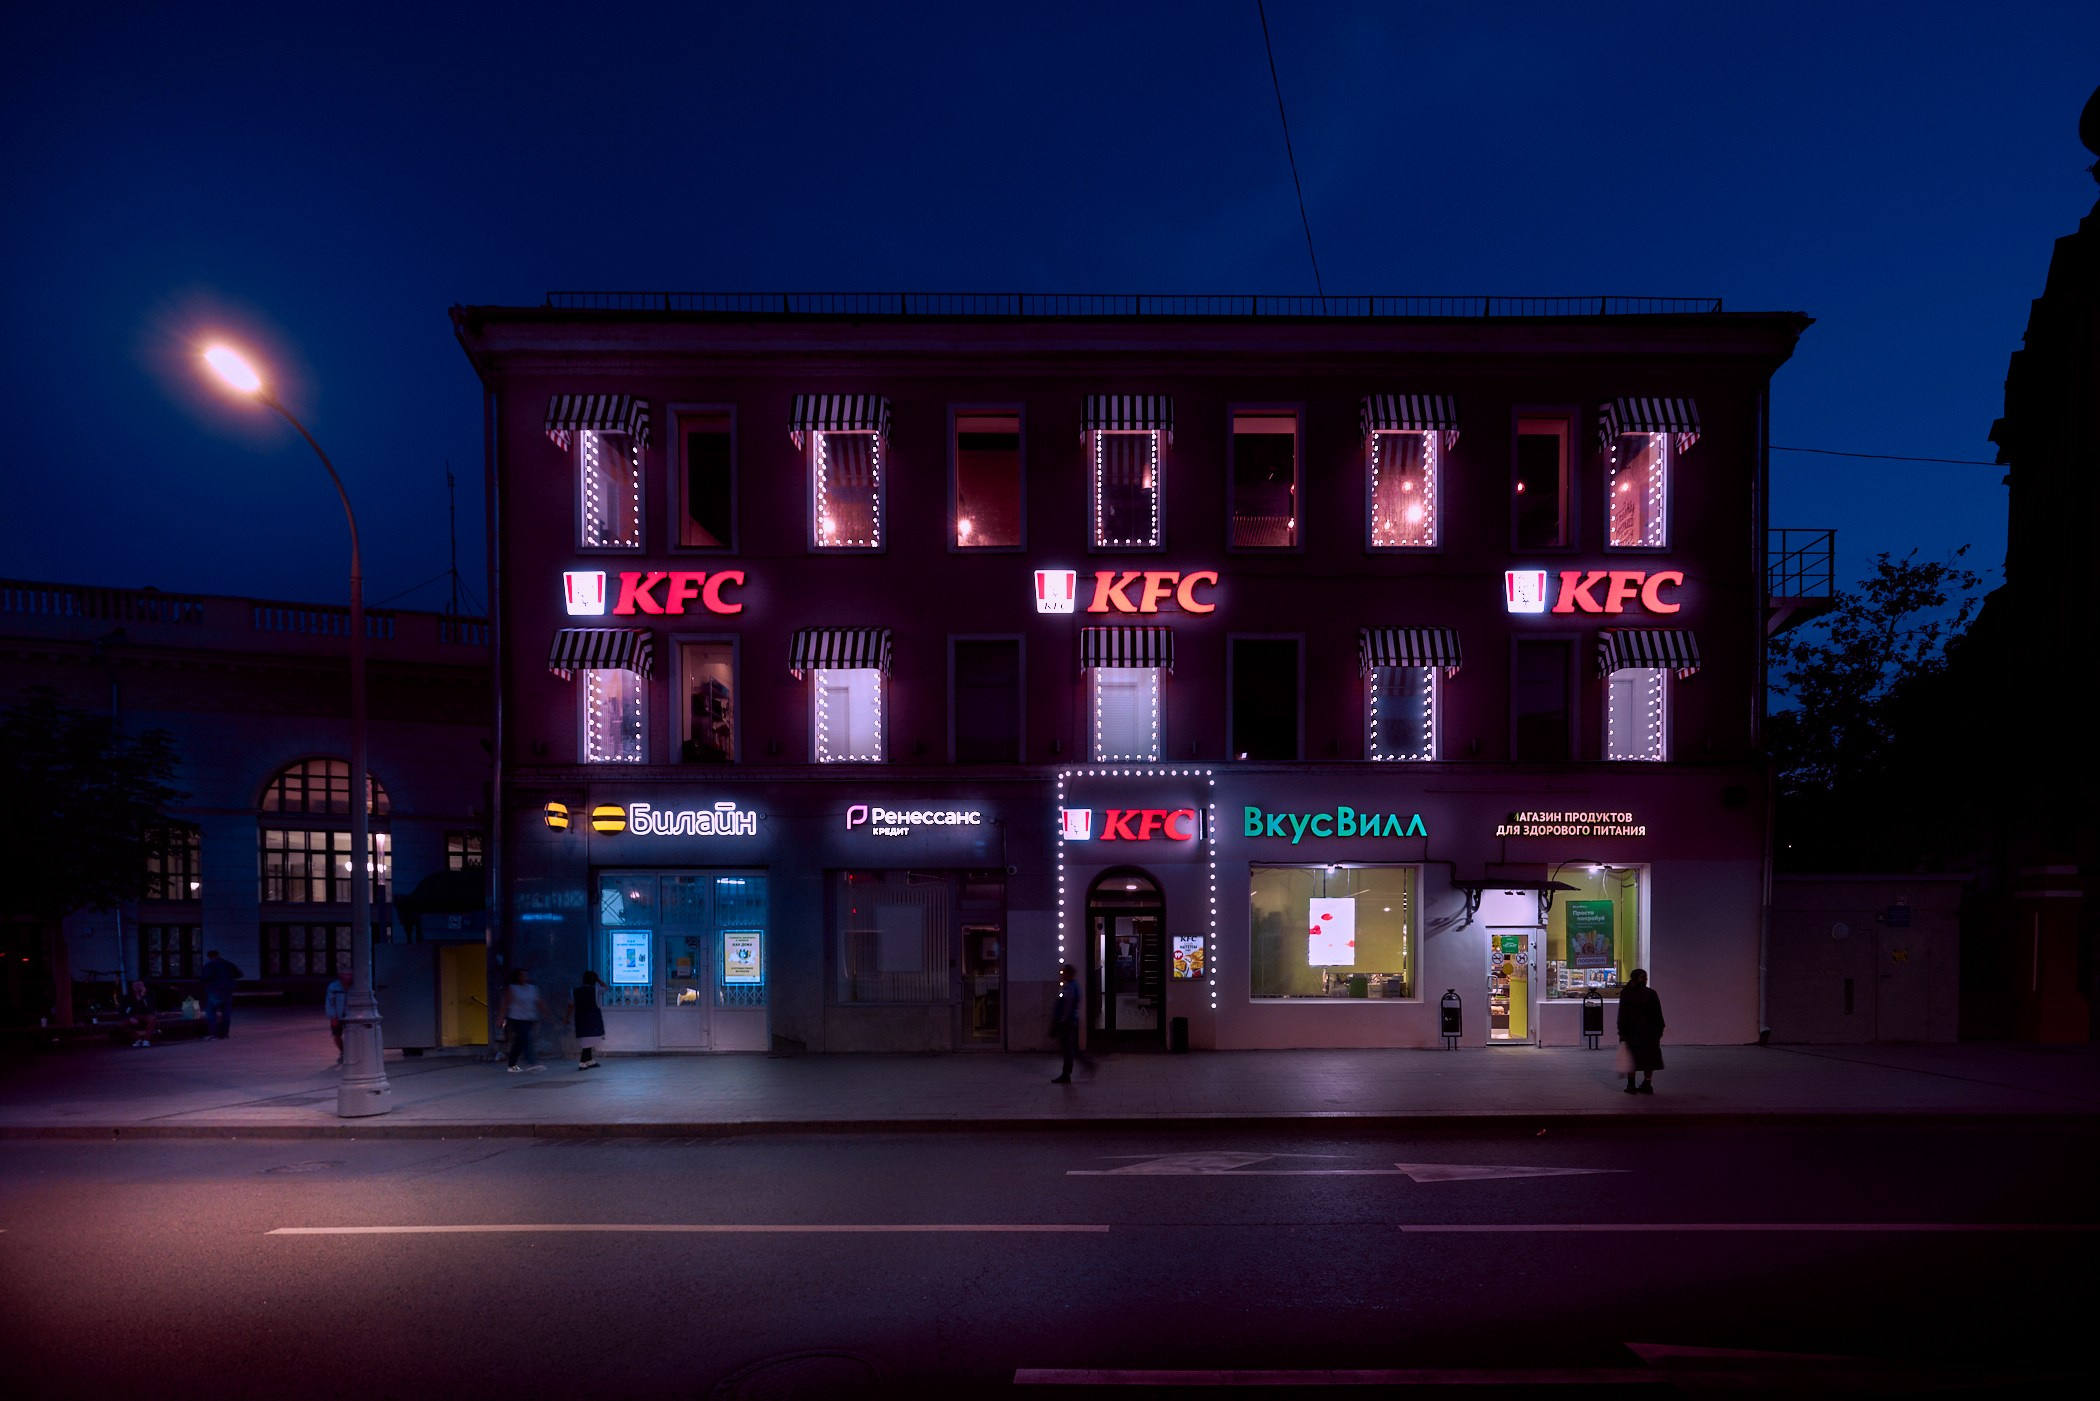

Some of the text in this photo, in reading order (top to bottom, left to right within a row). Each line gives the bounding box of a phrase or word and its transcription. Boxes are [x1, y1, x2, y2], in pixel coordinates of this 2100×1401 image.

[612, 571, 745, 615] KFC
[1087, 570, 1219, 613] KFC
[1552, 571, 1685, 613] KFC
[629, 801, 757, 836] Билайн
[871, 807, 981, 825] Ренессанс
[872, 827, 910, 837] КРЕДИТ
[1100, 808, 1196, 841] KFC
[1244, 806, 1428, 844] ВкусВилл
[1496, 824, 1646, 837] ДЛЯ ЗДОРОВОГО ПИТАНИЯ
[1564, 811, 1633, 824] ПРОДУКТОВ
